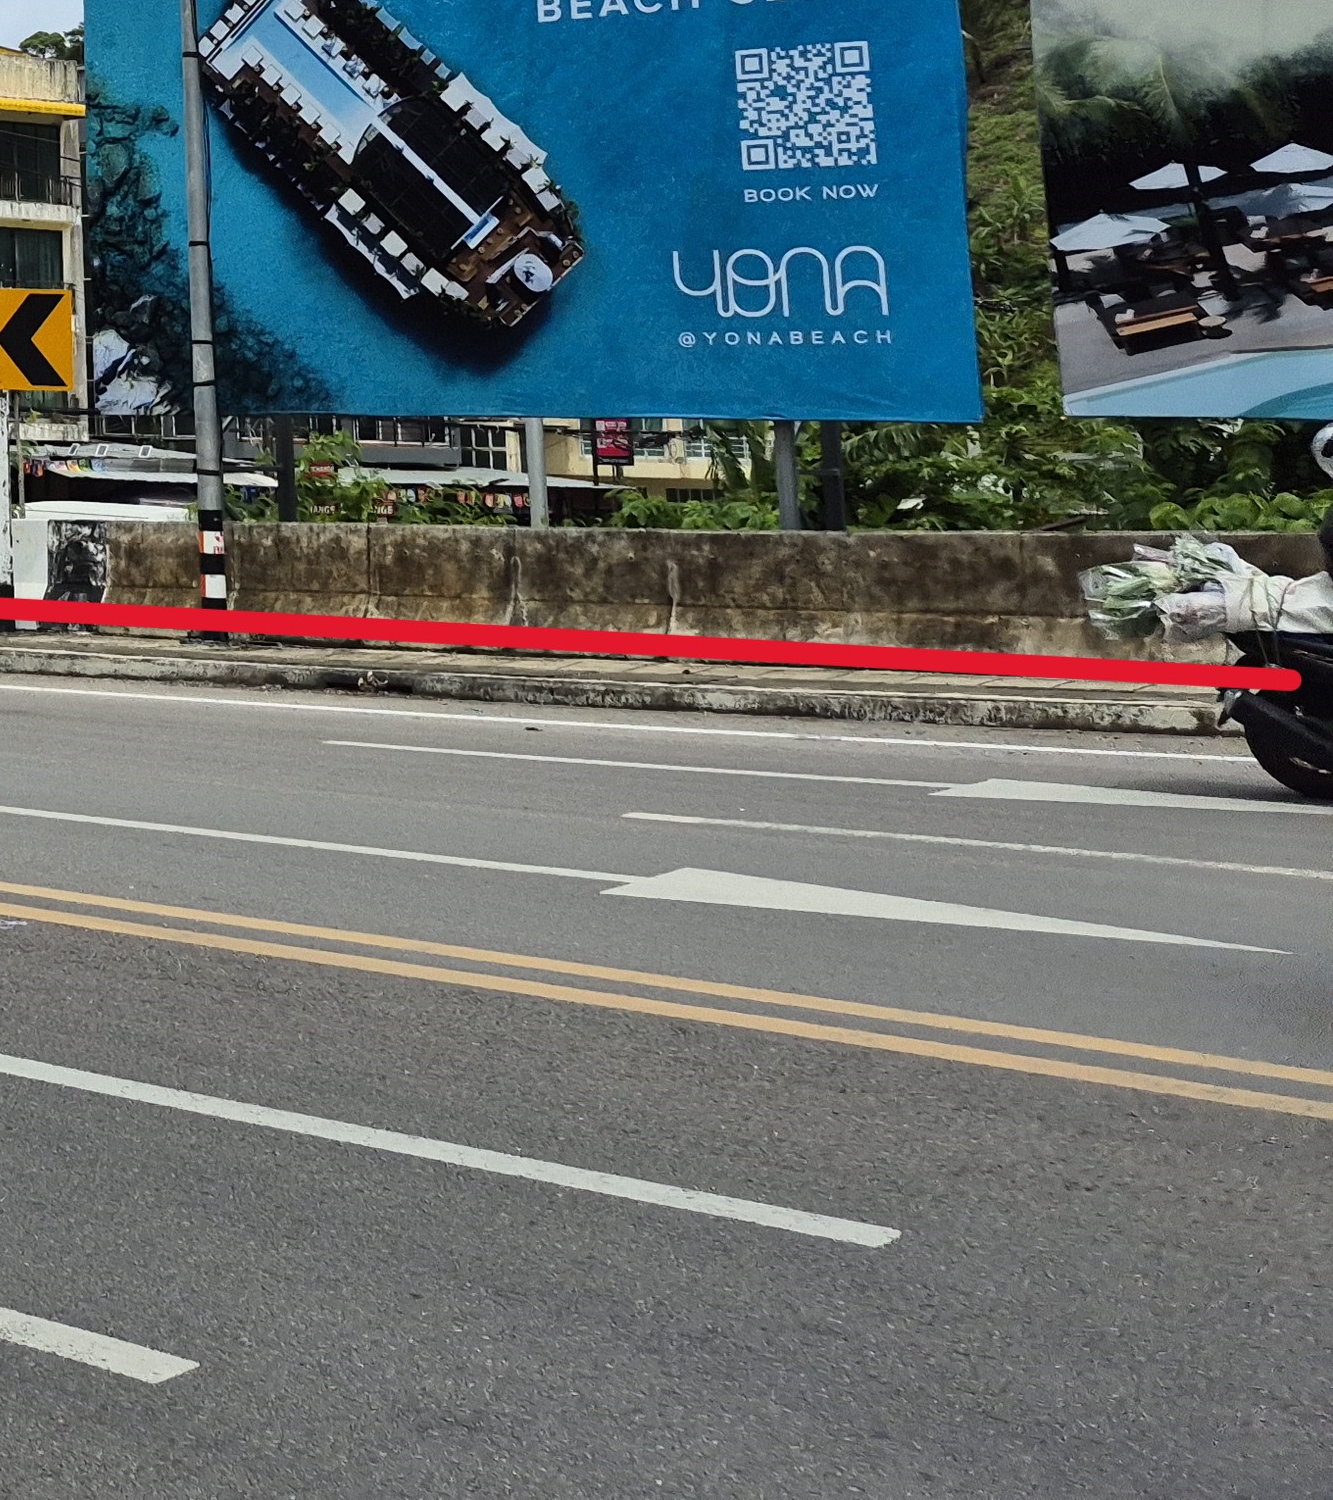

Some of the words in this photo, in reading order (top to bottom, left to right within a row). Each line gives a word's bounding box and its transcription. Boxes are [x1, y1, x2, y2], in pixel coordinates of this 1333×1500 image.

[743, 186, 813, 203] BOOK
[821, 183, 880, 200] NOW
[677, 329, 893, 348] @YONABEACH
